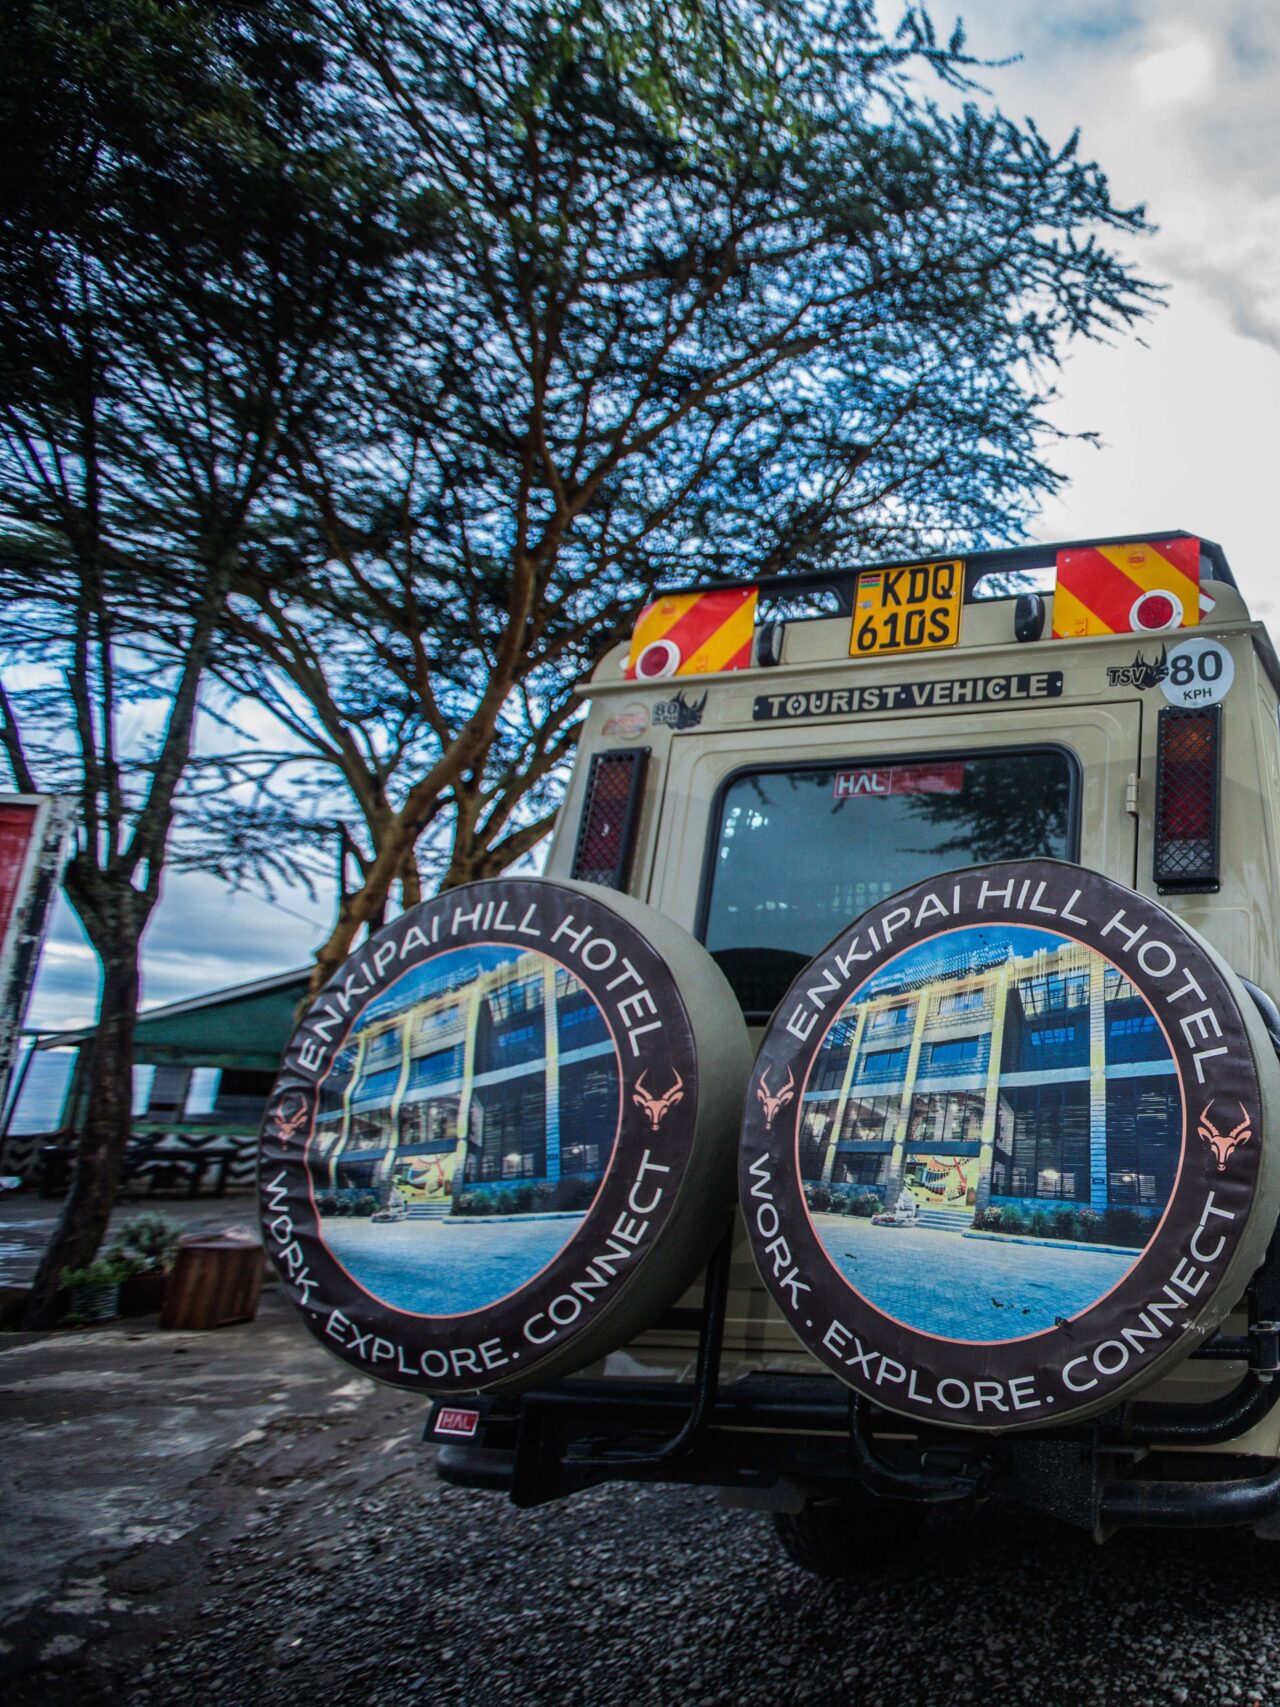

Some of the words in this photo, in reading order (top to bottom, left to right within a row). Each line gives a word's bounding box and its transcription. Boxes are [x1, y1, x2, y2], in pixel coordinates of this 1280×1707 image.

[882, 564, 954, 607] KDQ
[857, 608, 949, 651] 610S
[1107, 667, 1146, 686] TSV
[1170, 650, 1222, 686] 80
[654, 702, 679, 716] 80
[768, 687, 902, 717] TOURIST
[912, 675, 1048, 705] VEHICLE
[1183, 687, 1213, 701] KPH
[839, 774, 885, 794] HAL
[298, 916, 441, 1073] ENKIPAI
[450, 900, 541, 936] HILL
[551, 914, 662, 1057] HOTEL
[786, 886, 961, 1043] ENKIPAI
[976, 879, 1087, 926] HILL
[1101, 909, 1228, 1084] HOTEL
[523, 1150, 670, 1346] CONNECT
[1061, 1190, 1236, 1393] CONNECT
